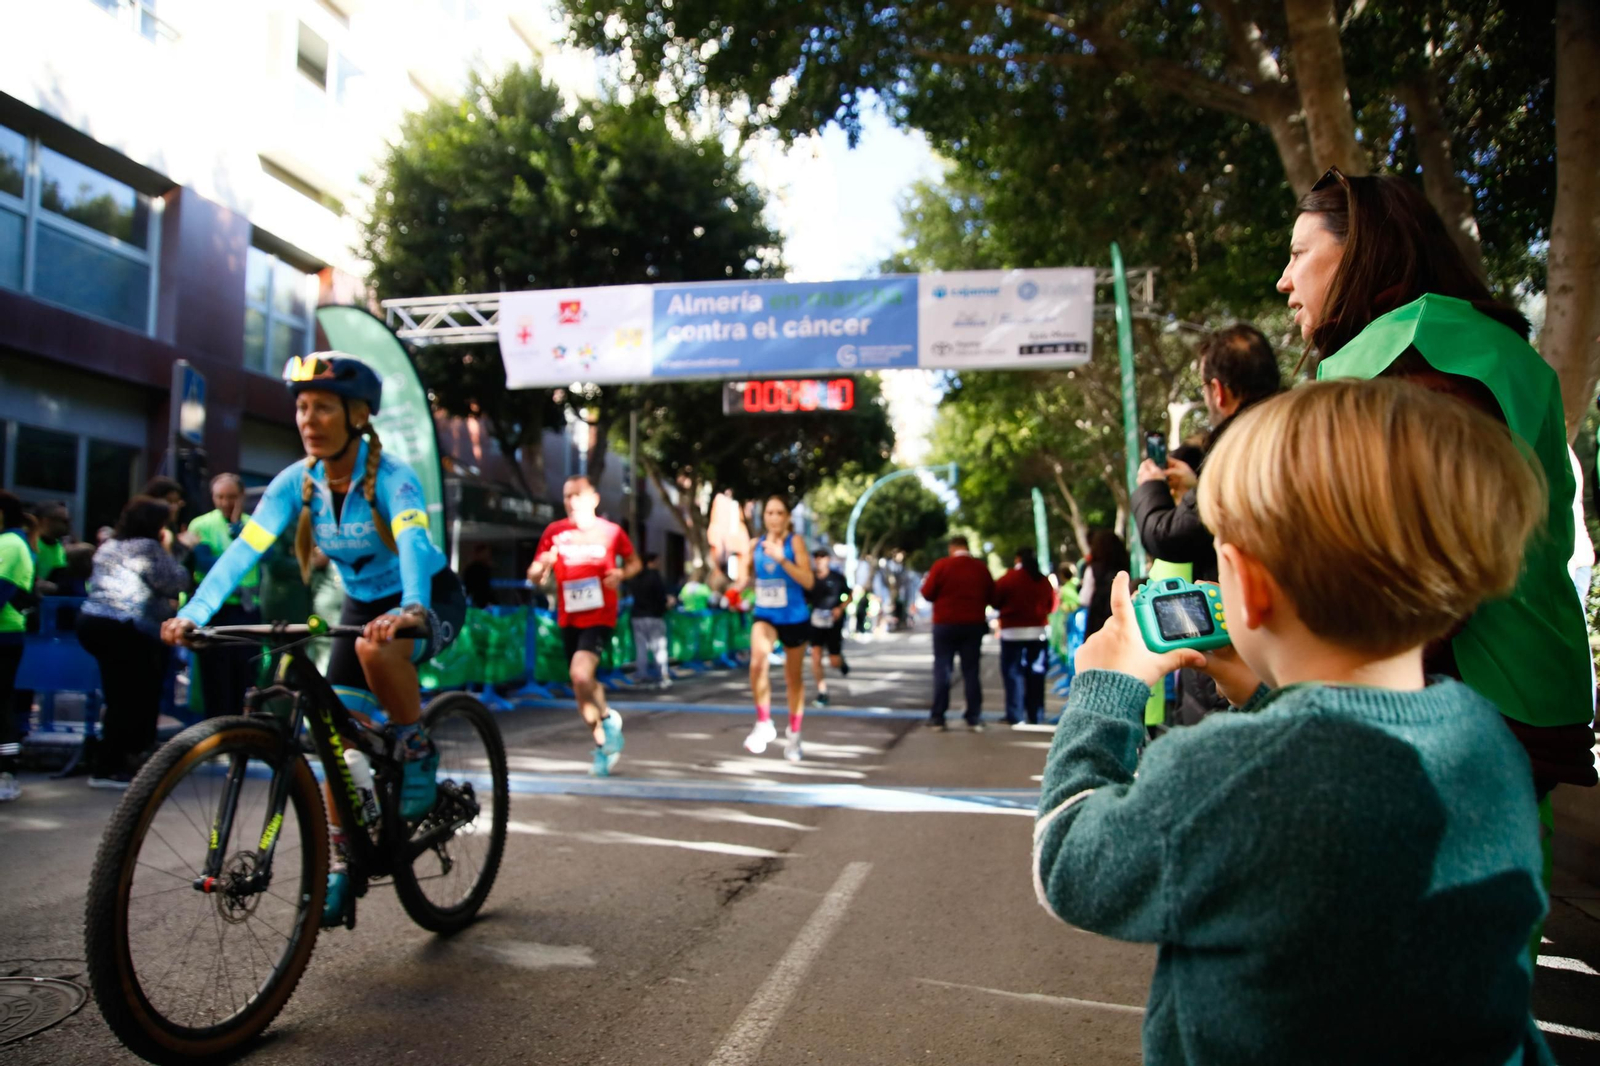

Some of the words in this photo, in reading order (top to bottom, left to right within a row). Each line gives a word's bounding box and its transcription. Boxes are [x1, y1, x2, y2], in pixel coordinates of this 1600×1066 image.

[667, 291, 763, 316] Almería
[769, 293, 800, 310] en
[806, 287, 903, 308] marcha
[666, 320, 748, 342] contra
[752, 316, 778, 339] el
[782, 315, 871, 338] cáncer
